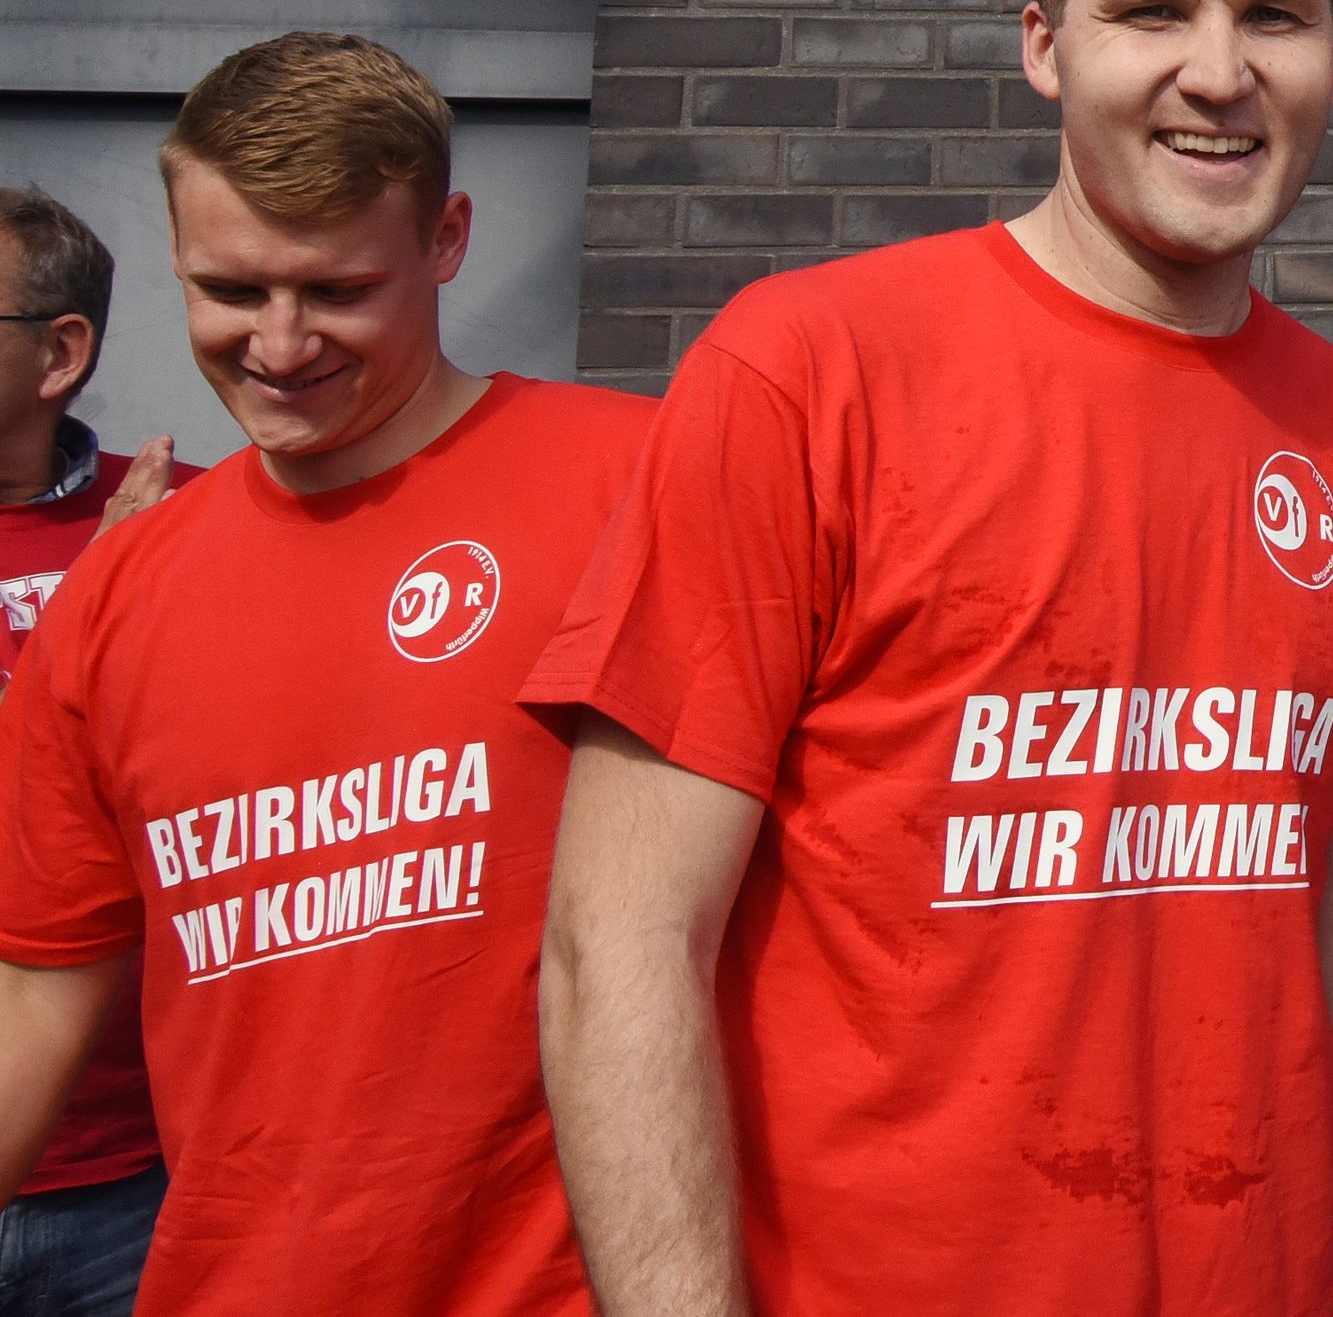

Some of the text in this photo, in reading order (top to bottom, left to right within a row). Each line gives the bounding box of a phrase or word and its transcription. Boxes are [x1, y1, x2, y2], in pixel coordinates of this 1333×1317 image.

[146, 741, 491, 889] BEZIRKSLIGA
[942, 803, 1310, 895] WIR KOMME
[254, 841, 486, 953] KOMMEN!
